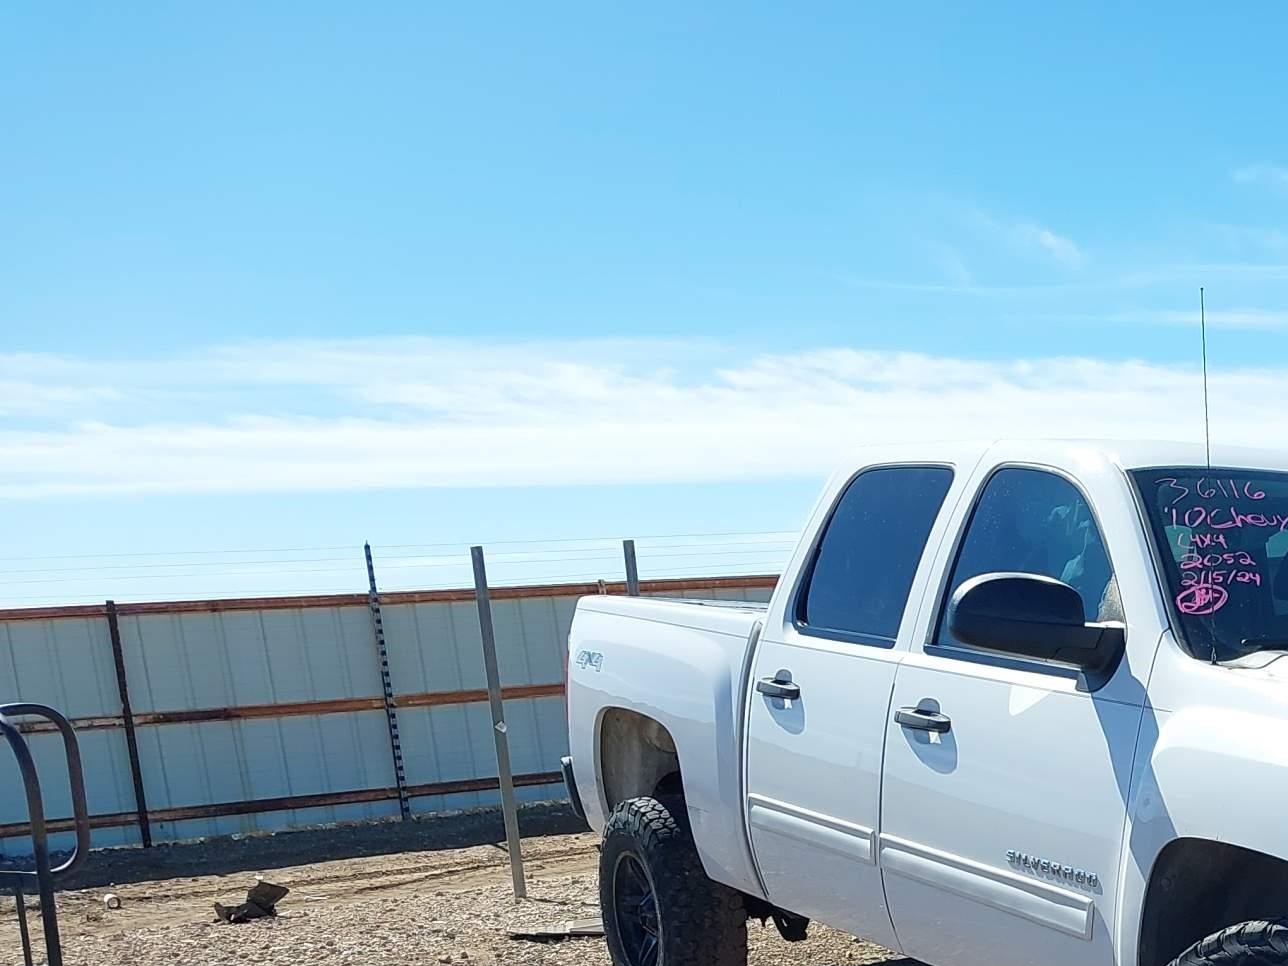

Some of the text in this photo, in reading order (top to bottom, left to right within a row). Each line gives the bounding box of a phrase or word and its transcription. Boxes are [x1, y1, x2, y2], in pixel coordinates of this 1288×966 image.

[1154, 477, 1266, 505] 36116
[1180, 551, 1257, 569] 2052
[1181, 569, 1261, 587] 2/15/24
[1006, 849, 1099, 888] SILVERADO
